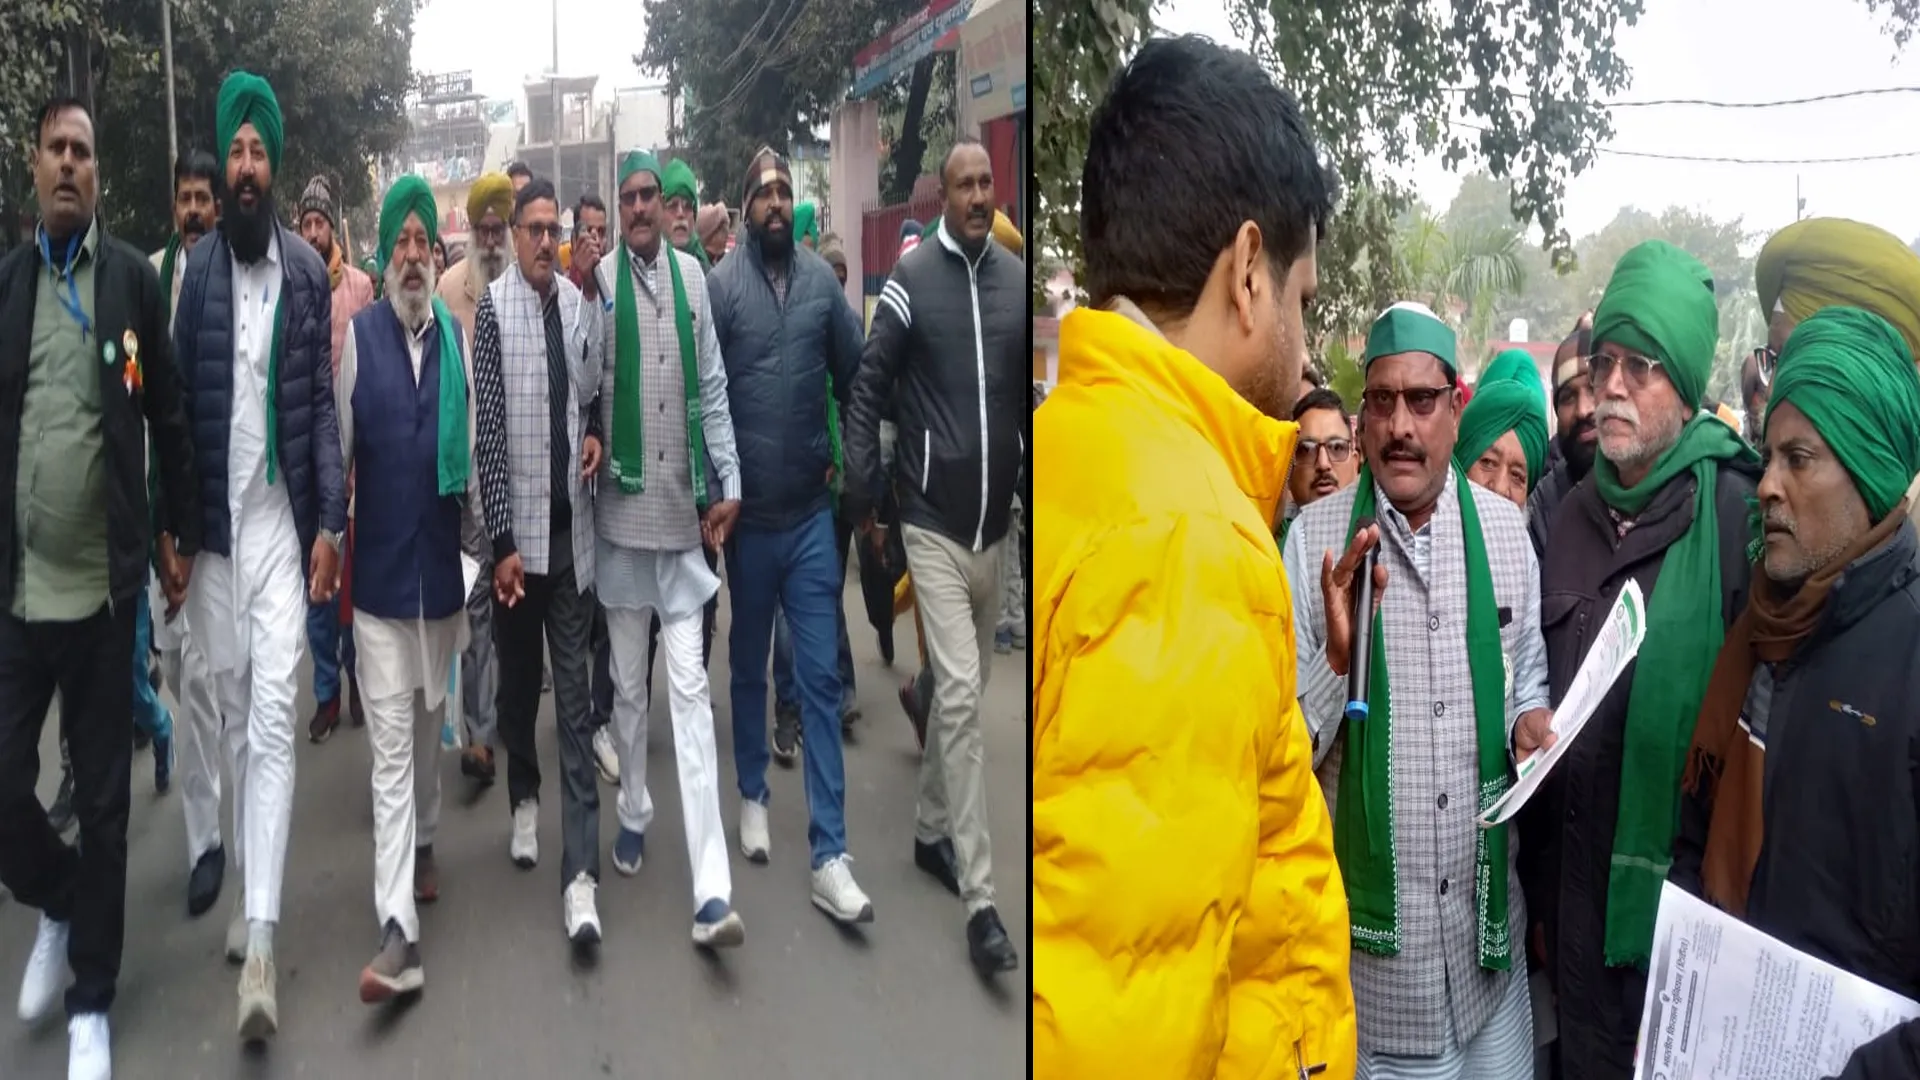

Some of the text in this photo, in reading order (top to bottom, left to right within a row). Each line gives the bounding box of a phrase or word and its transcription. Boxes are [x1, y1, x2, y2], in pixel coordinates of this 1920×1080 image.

[1671, 973, 1684, 1004] यूनियन
[1666, 1005, 1678, 1036] किसान
[1663, 1036, 1675, 1068] भारतीय
